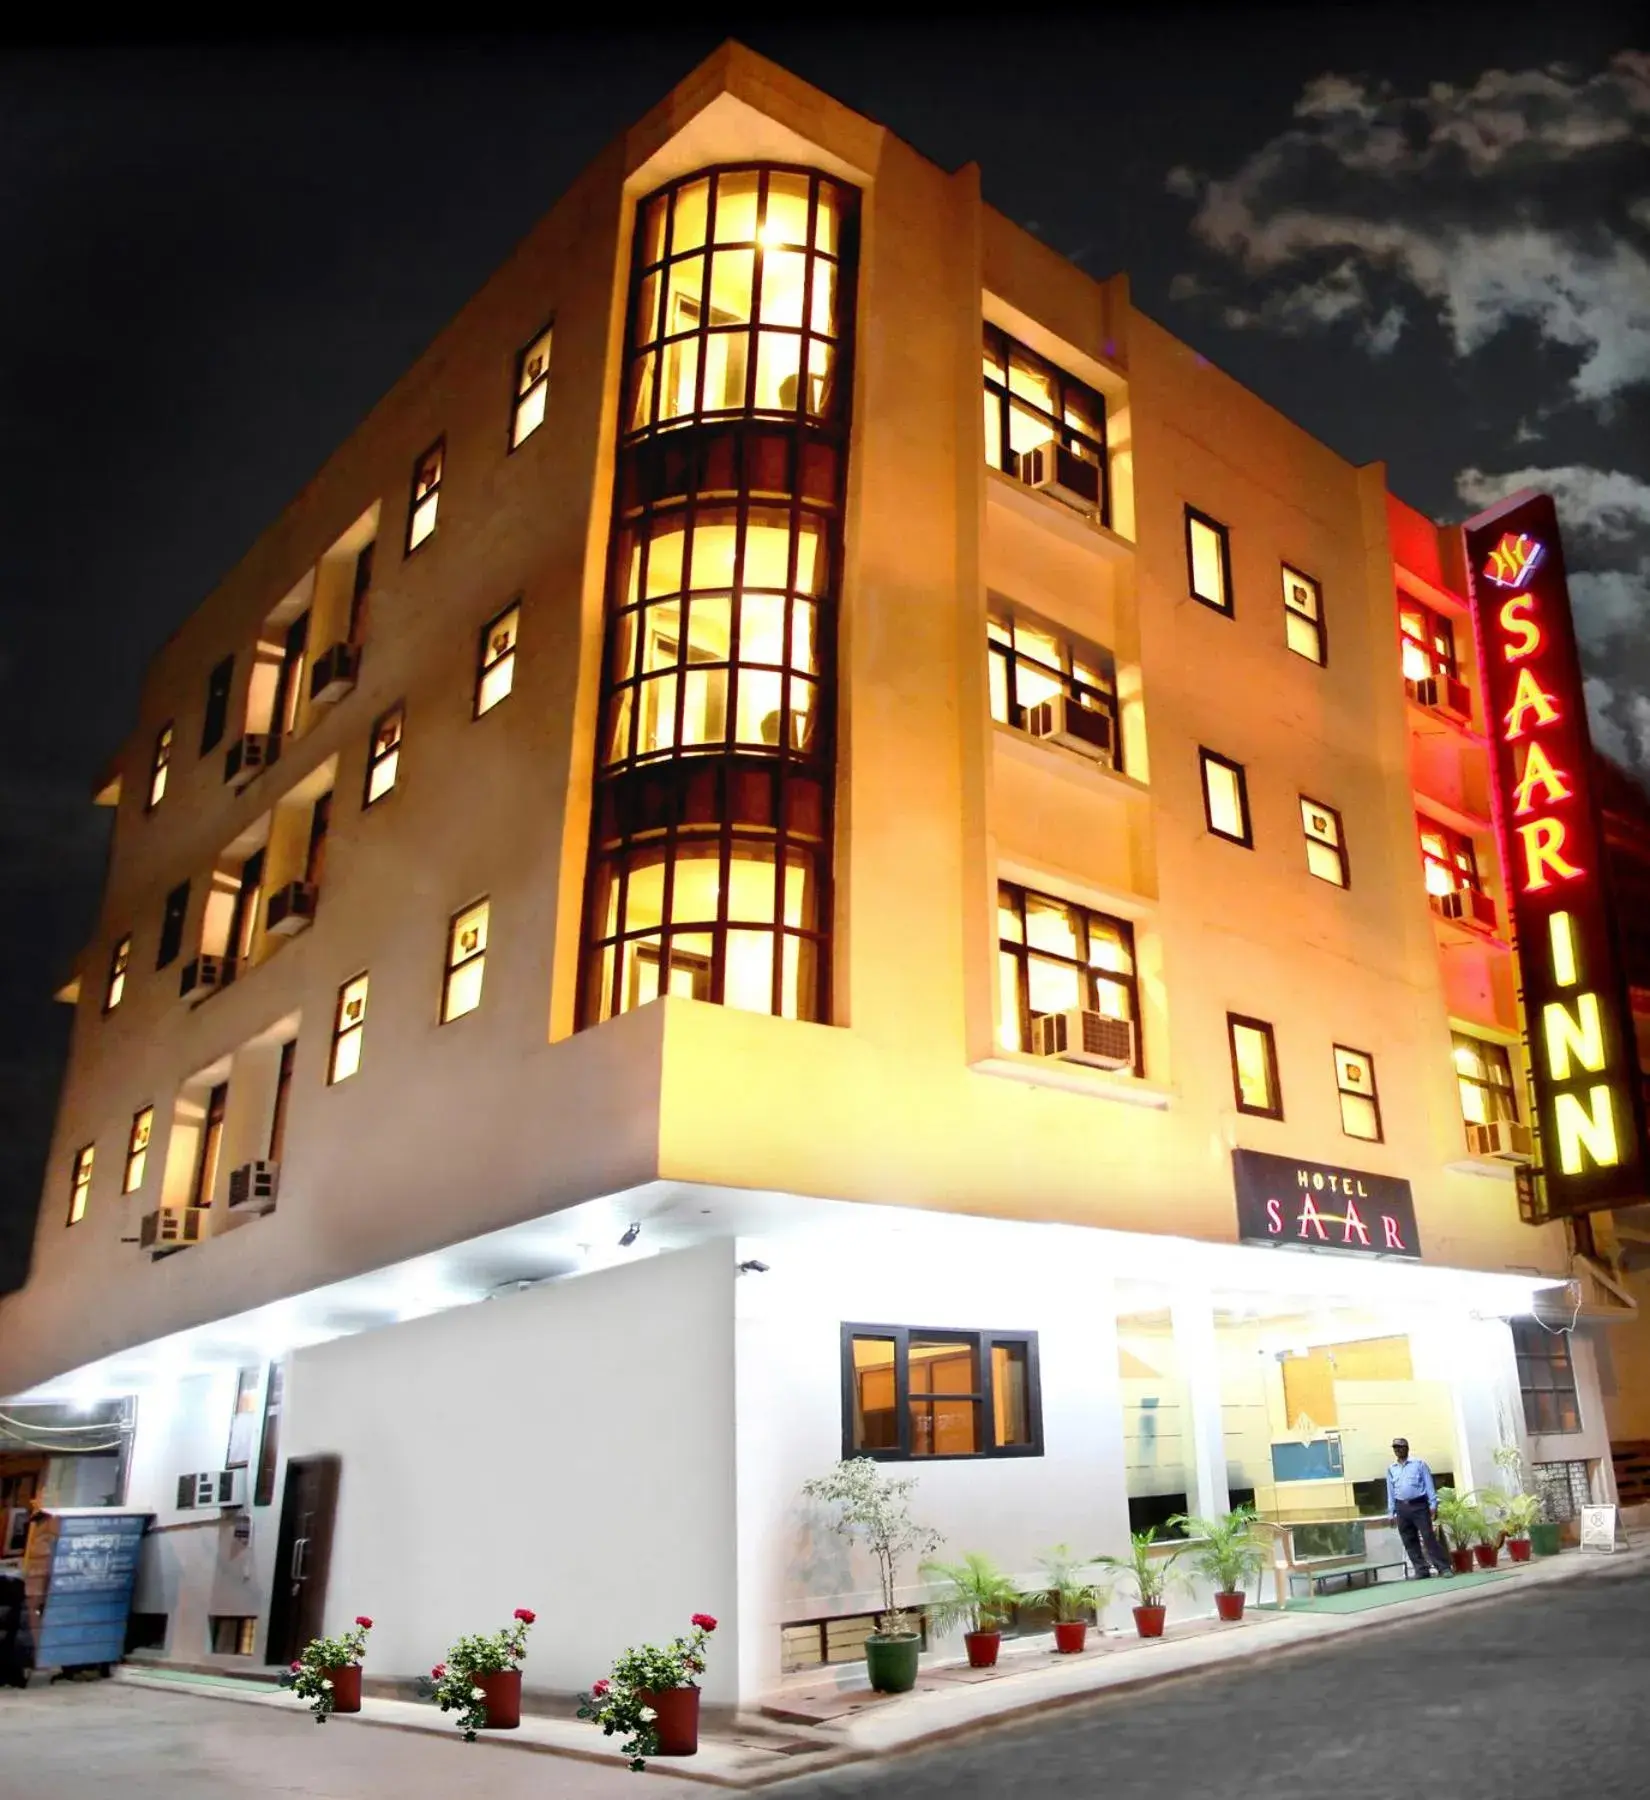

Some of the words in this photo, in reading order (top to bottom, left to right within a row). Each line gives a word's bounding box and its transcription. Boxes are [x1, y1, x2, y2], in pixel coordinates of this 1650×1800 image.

[1499, 594, 1583, 892] SAAR
[1544, 911, 1618, 1176] INN
[1297, 1170, 1368, 1197] HOTEL
[1266, 1193, 1406, 1250] SAAR
